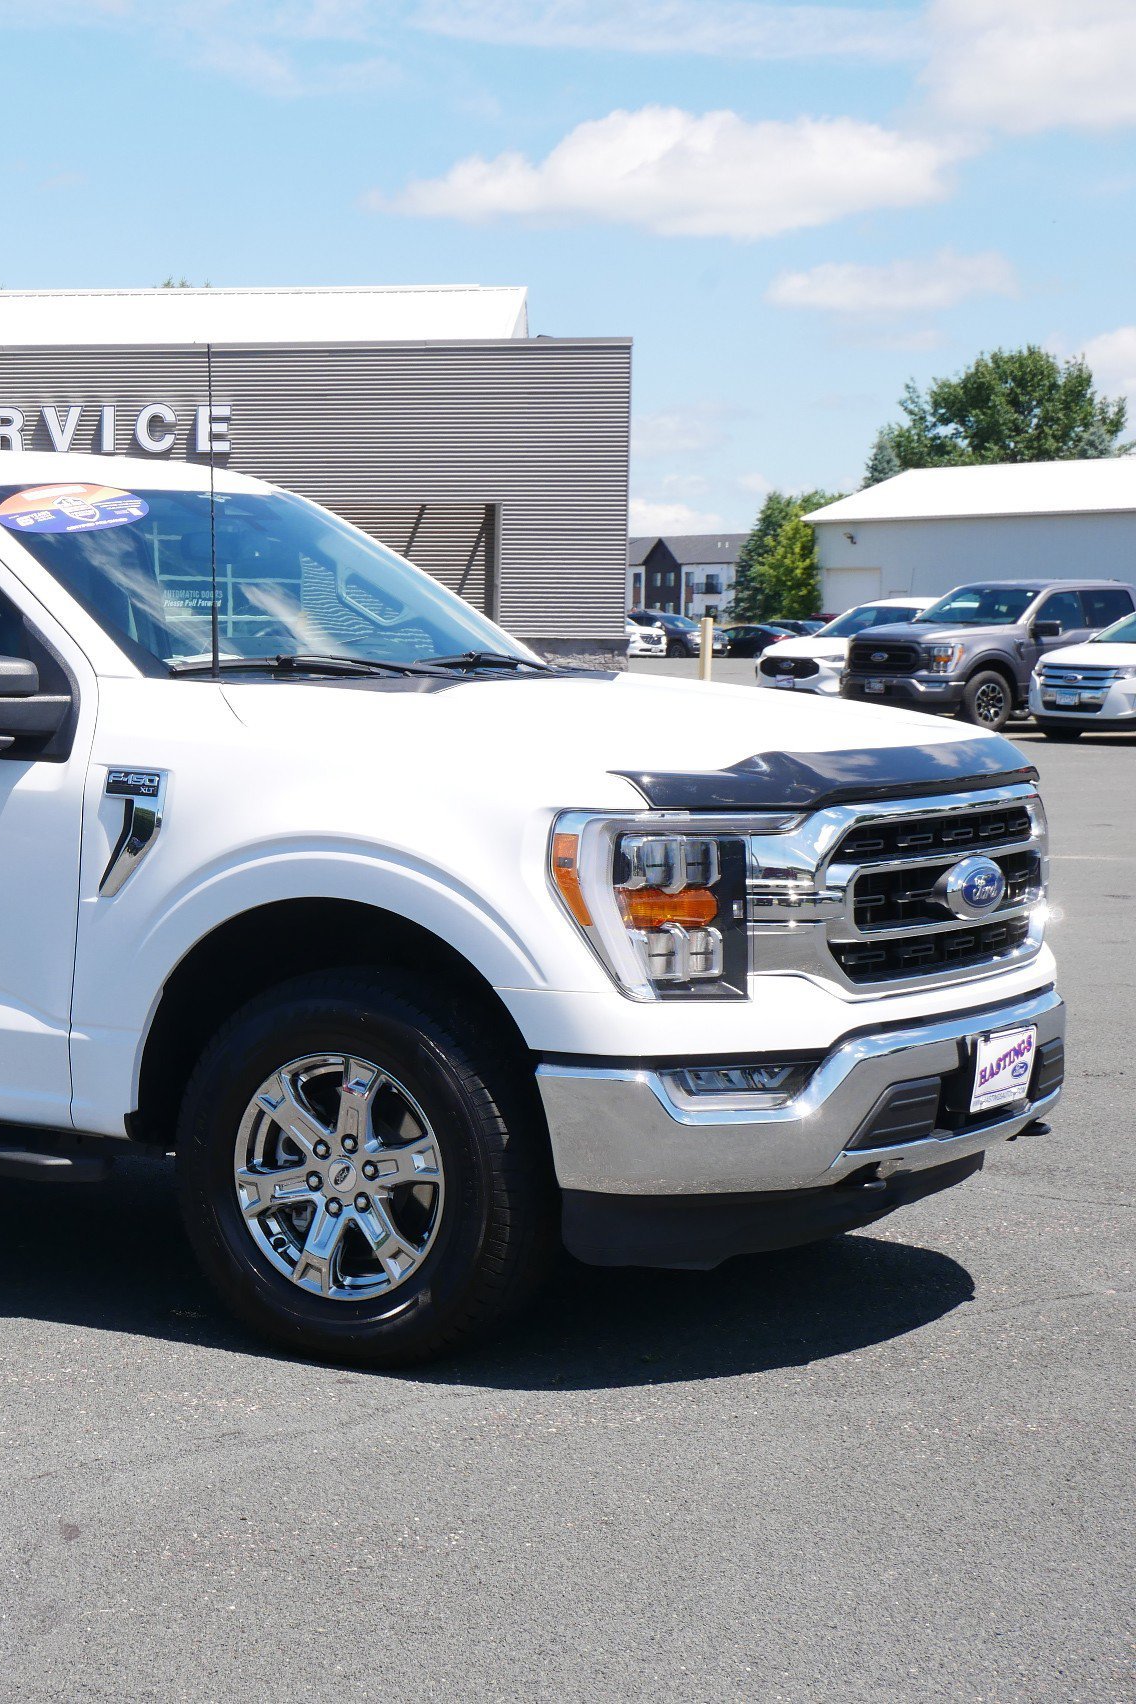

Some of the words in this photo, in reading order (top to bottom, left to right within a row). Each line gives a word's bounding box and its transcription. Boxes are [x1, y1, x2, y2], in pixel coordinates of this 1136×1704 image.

[164, 599, 184, 607] Please
[107, 771, 159, 786] F-150
[140, 786, 154, 794] XLT
[971, 873, 997, 901] Ford
[978, 1033, 1033, 1088] HASTINGS
